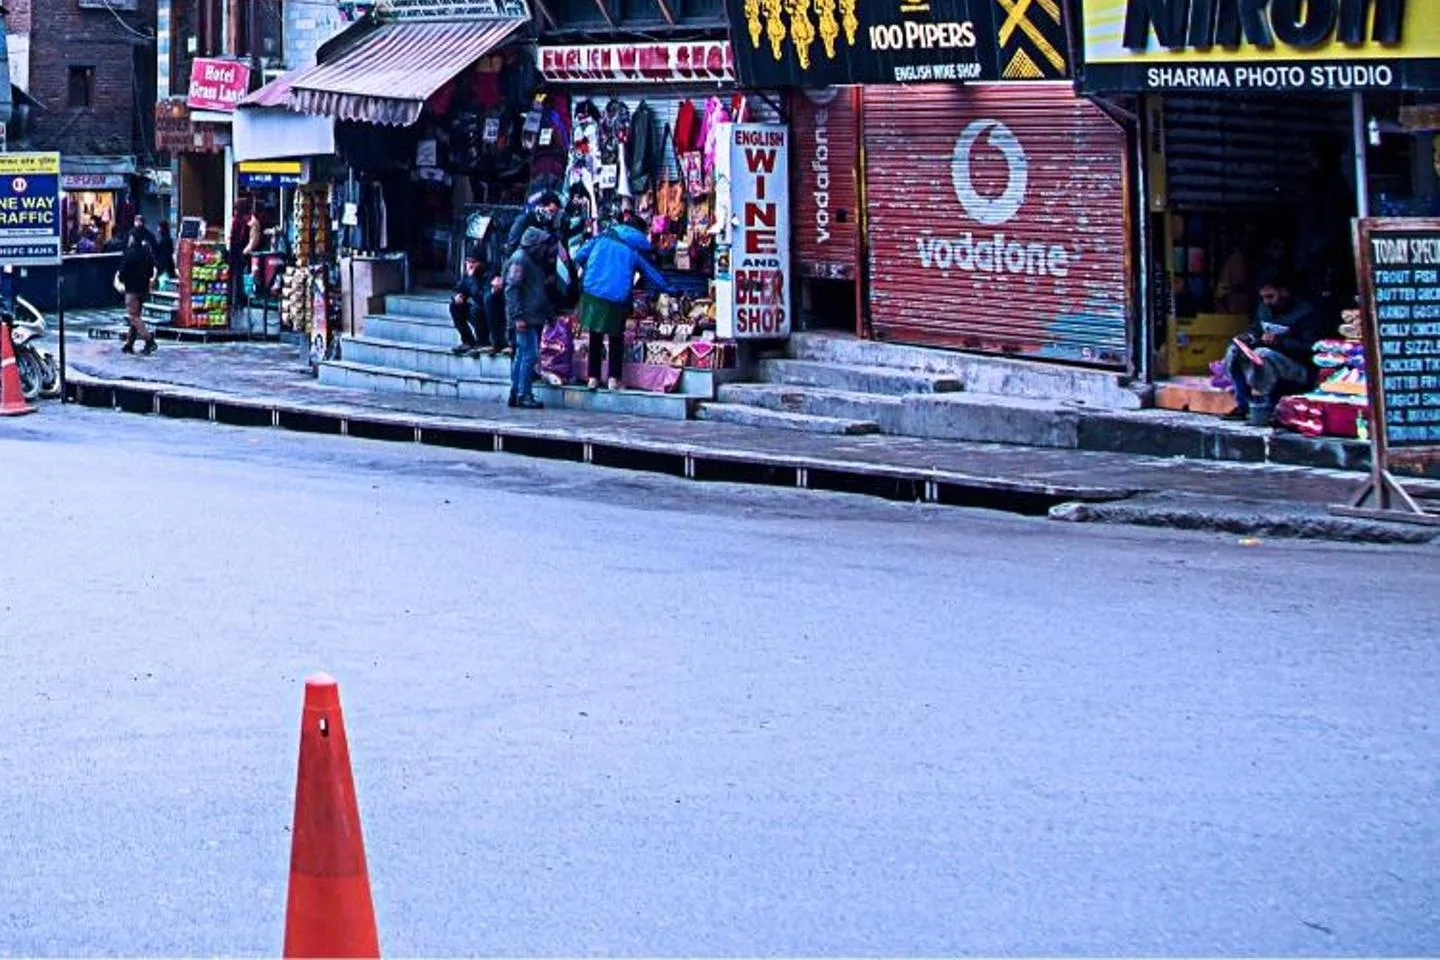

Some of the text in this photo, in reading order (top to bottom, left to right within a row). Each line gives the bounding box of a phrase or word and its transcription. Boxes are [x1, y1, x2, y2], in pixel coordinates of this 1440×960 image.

[869, 20, 977, 50] 100 PIPERS
[205, 64, 235, 84] Hotel
[894, 65, 932, 81] ENGLISH
[959, 62, 982, 78] SHOP
[1147, 65, 1393, 88] SHARMA PHOTO STUDIO
[190, 81, 246, 101] Grass Land
[735, 130, 785, 147] ENGLISH
[21, 196, 55, 210] WAY
[744, 148, 778, 254] WINE
[27, 246, 54, 255] BANK
[1371, 238, 1440, 264] TODAY SPECI
[742, 258, 780, 267] AND
[735, 269, 785, 305] BEER
[736, 307, 786, 333] SHOP
